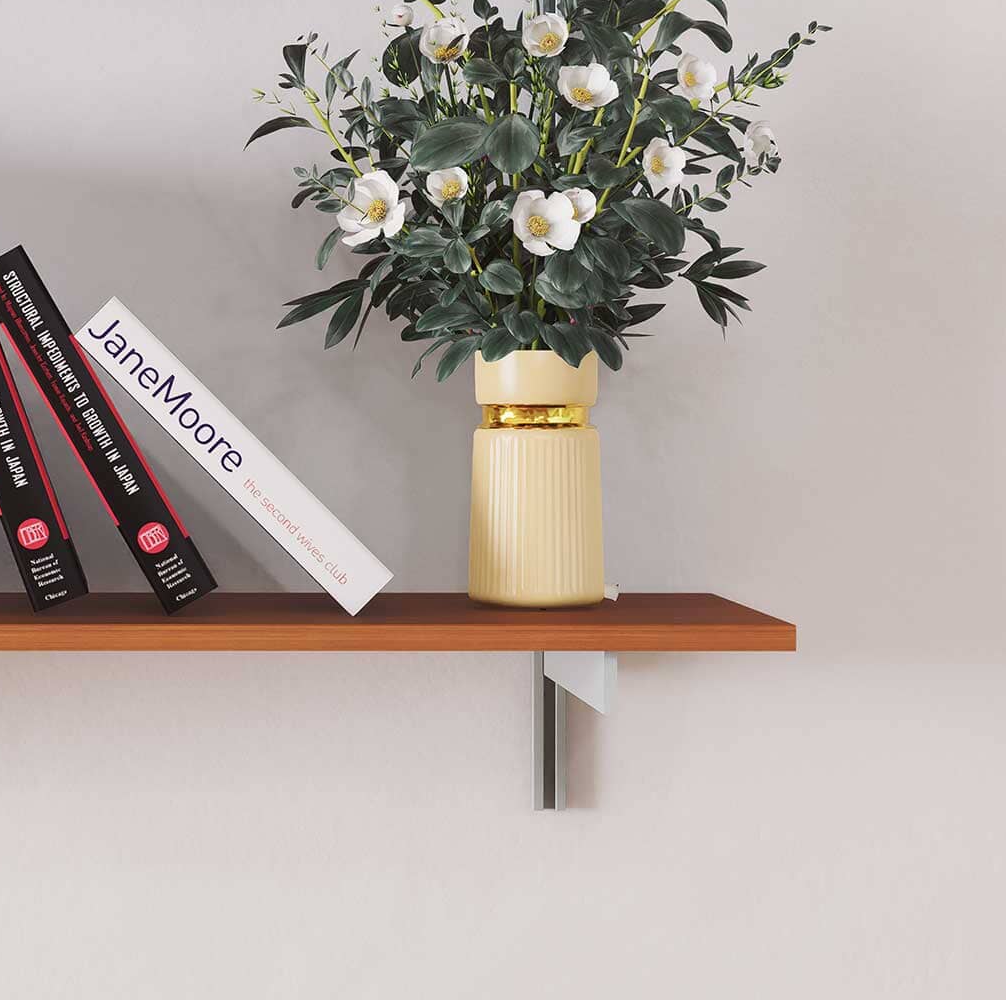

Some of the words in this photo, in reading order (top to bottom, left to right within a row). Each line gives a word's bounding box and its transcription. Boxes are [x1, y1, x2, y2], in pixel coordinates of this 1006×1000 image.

[3, 271, 43, 330] STRUCTURAL
[37, 330, 80, 392] IMPEDIMENTS
[74, 392, 89, 408] TO
[82, 408, 113, 448] GROWTH
[106, 448, 121, 462] IN
[114, 465, 139, 495] JAPAN
[88, 320, 242, 472] JaneMoore
[1, 439, 15, 452] IN
[6, 457, 28, 487] JAPAN
[243, 479, 261, 498] the
[261, 498, 300, 534] second
[297, 533, 325, 562] wives
[325, 562, 347, 584] club
